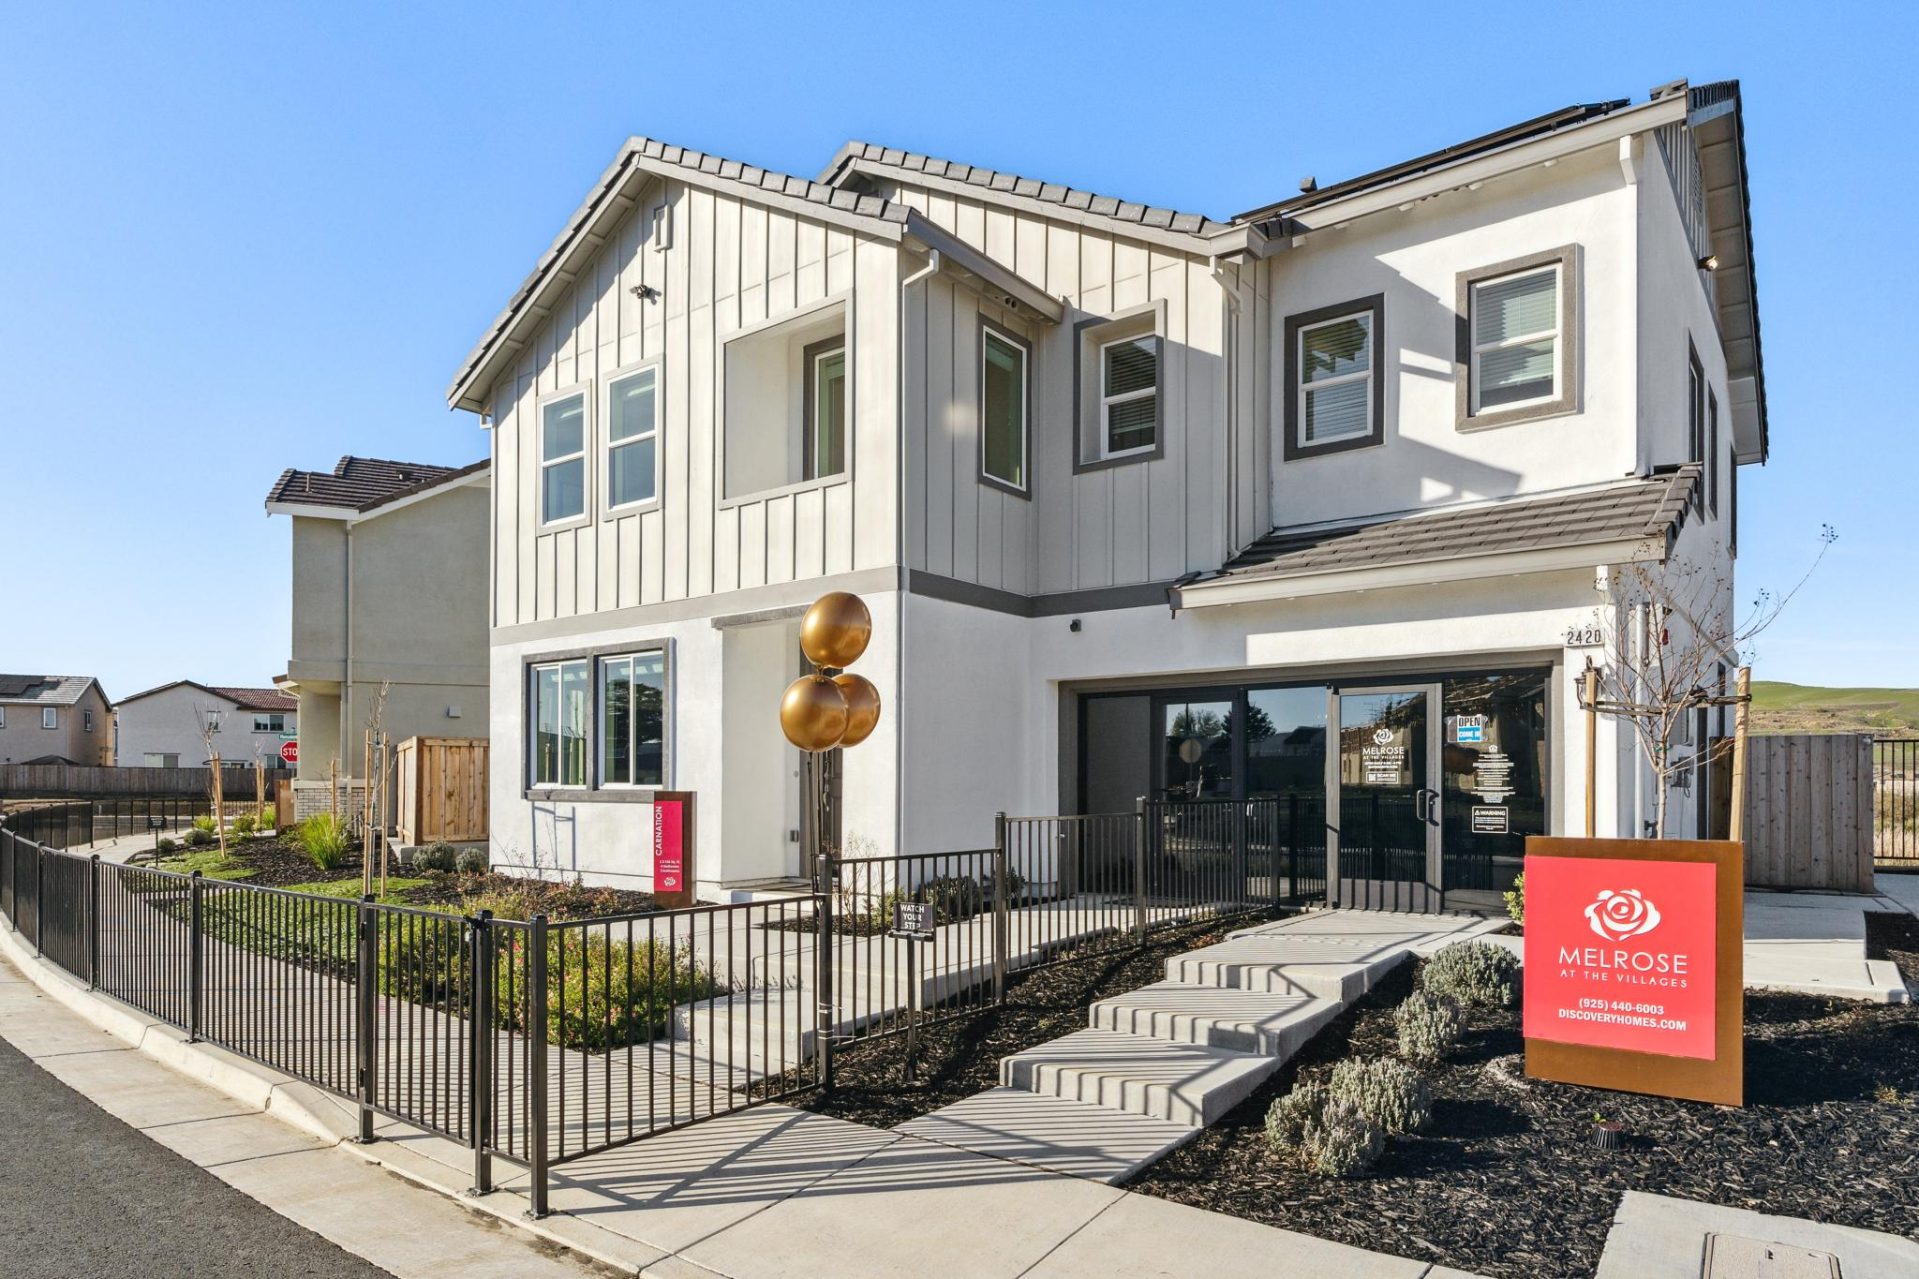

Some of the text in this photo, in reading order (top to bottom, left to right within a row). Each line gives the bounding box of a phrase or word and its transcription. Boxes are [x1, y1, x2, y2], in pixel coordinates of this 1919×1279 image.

[1567, 630, 1601, 644] 2420
[1458, 717, 1480, 726] OPEN
[283, 748, 298, 756] STO
[1362, 746, 1404, 755] MELROSE
[655, 806, 663, 856] CARNATION
[900, 904, 924, 913] WATCH
[1559, 946, 1687, 974] MELROSE
[1560, 969, 1687, 988] AT THE VILLAGES
[1579, 998, 1664, 1015] (925) 440-6003
[1559, 1008, 1687, 1031] DISCOVERYHOMES.COM
